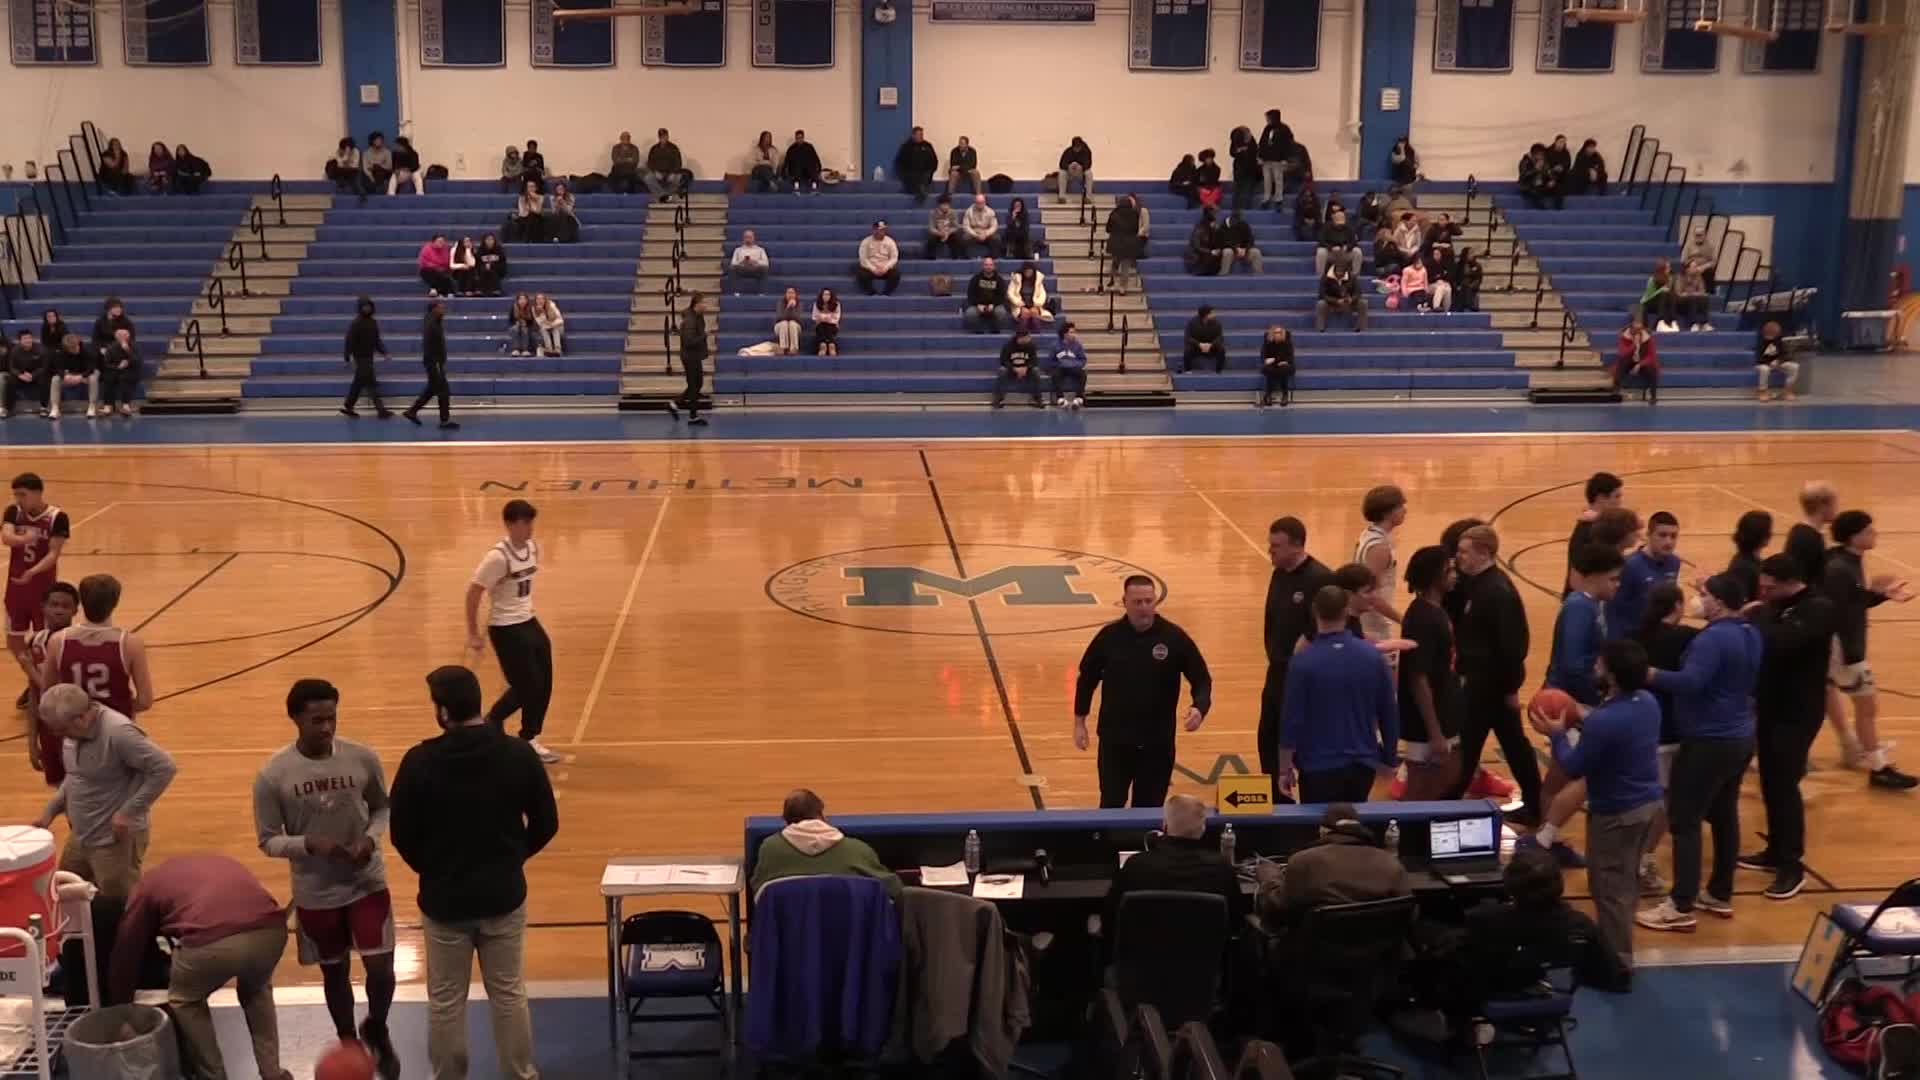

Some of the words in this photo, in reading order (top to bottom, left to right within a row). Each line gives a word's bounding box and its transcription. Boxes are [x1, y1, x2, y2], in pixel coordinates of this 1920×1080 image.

[479, 477, 863, 492] METHUEN
[24, 543, 36, 562] 5
[842, 565, 1099, 606] M
[72, 662, 110, 698] 12
[294, 775, 356, 796] LOWELL
